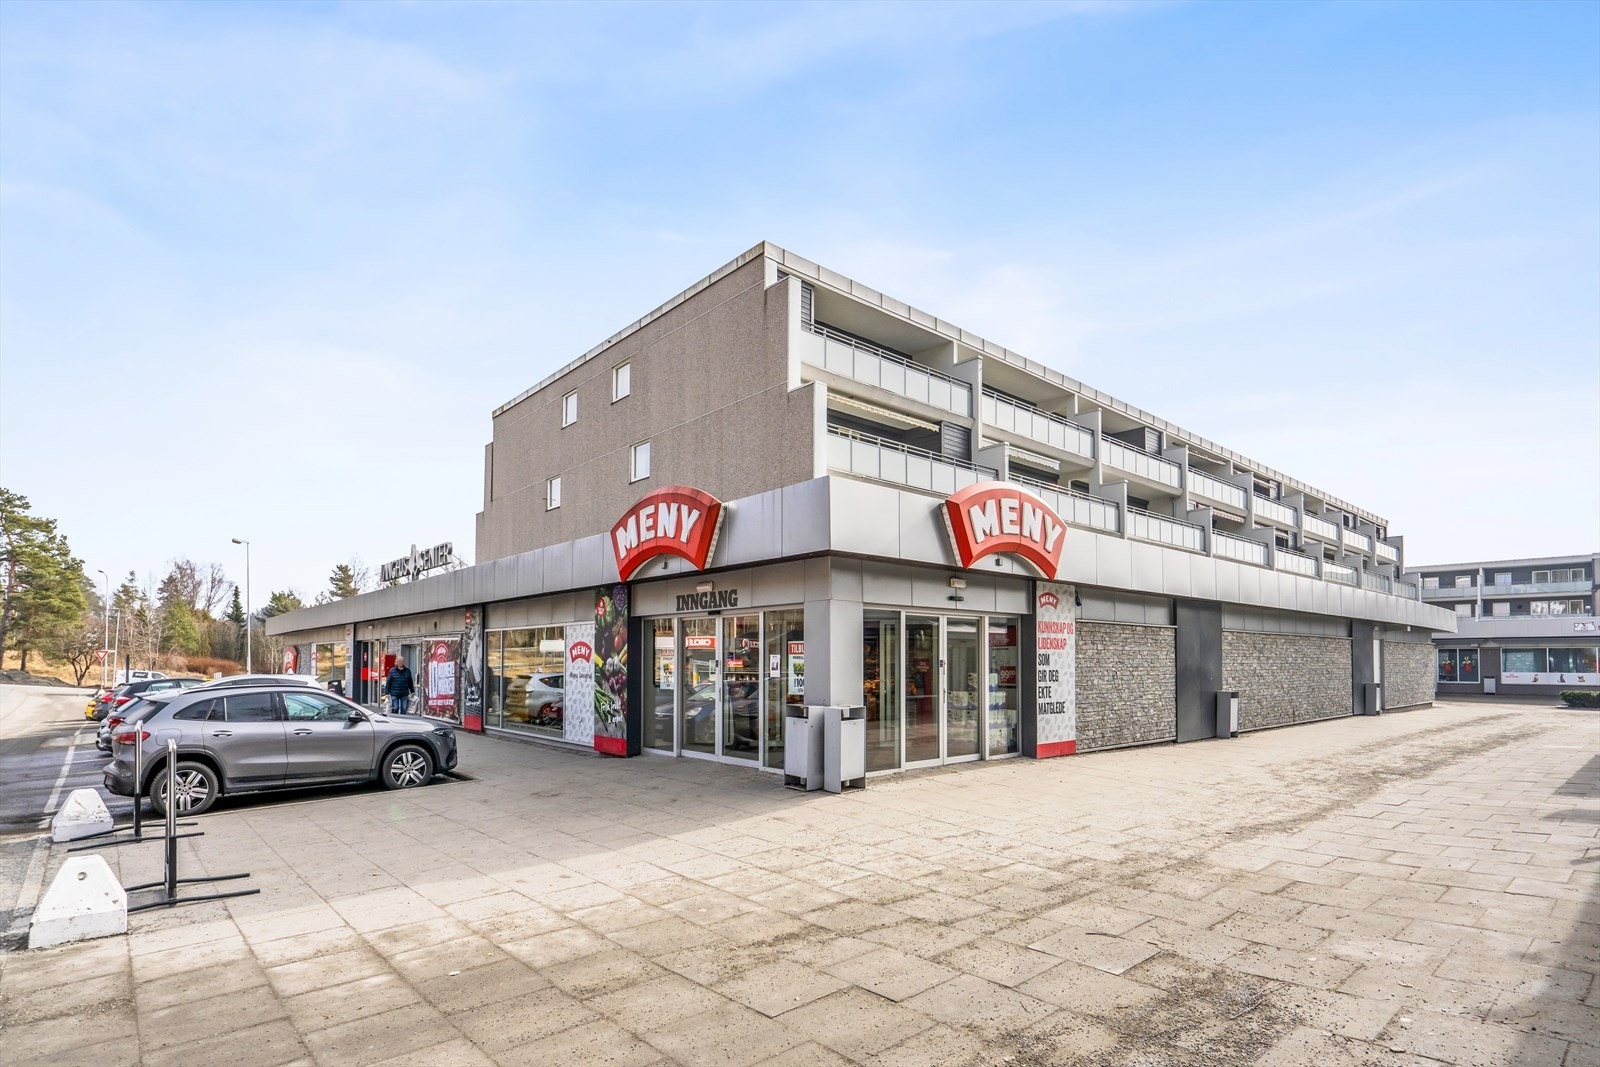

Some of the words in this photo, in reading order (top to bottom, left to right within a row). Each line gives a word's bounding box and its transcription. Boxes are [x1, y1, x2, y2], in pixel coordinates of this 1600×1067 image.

[616, 502, 701, 560] MENY
[968, 498, 1063, 554] MENY
[420, 541, 454, 571] SENTER
[676, 589, 738, 611] INNGANG
[1040, 595, 1057, 604] MENY
[1037, 621, 1066, 634] KUNNSKAP
[1066, 622, 1074, 634] OG
[1037, 637, 1067, 650] LIDENSKAP
[571, 645, 590, 658] MENY
[1037, 653, 1050, 666] SOM
[1037, 670, 1047, 682] GIR
[1048, 670, 1059, 682] DEG
[1038, 686, 1052, 699] EKTE
[1038, 701, 1066, 715] MATGLEDE
